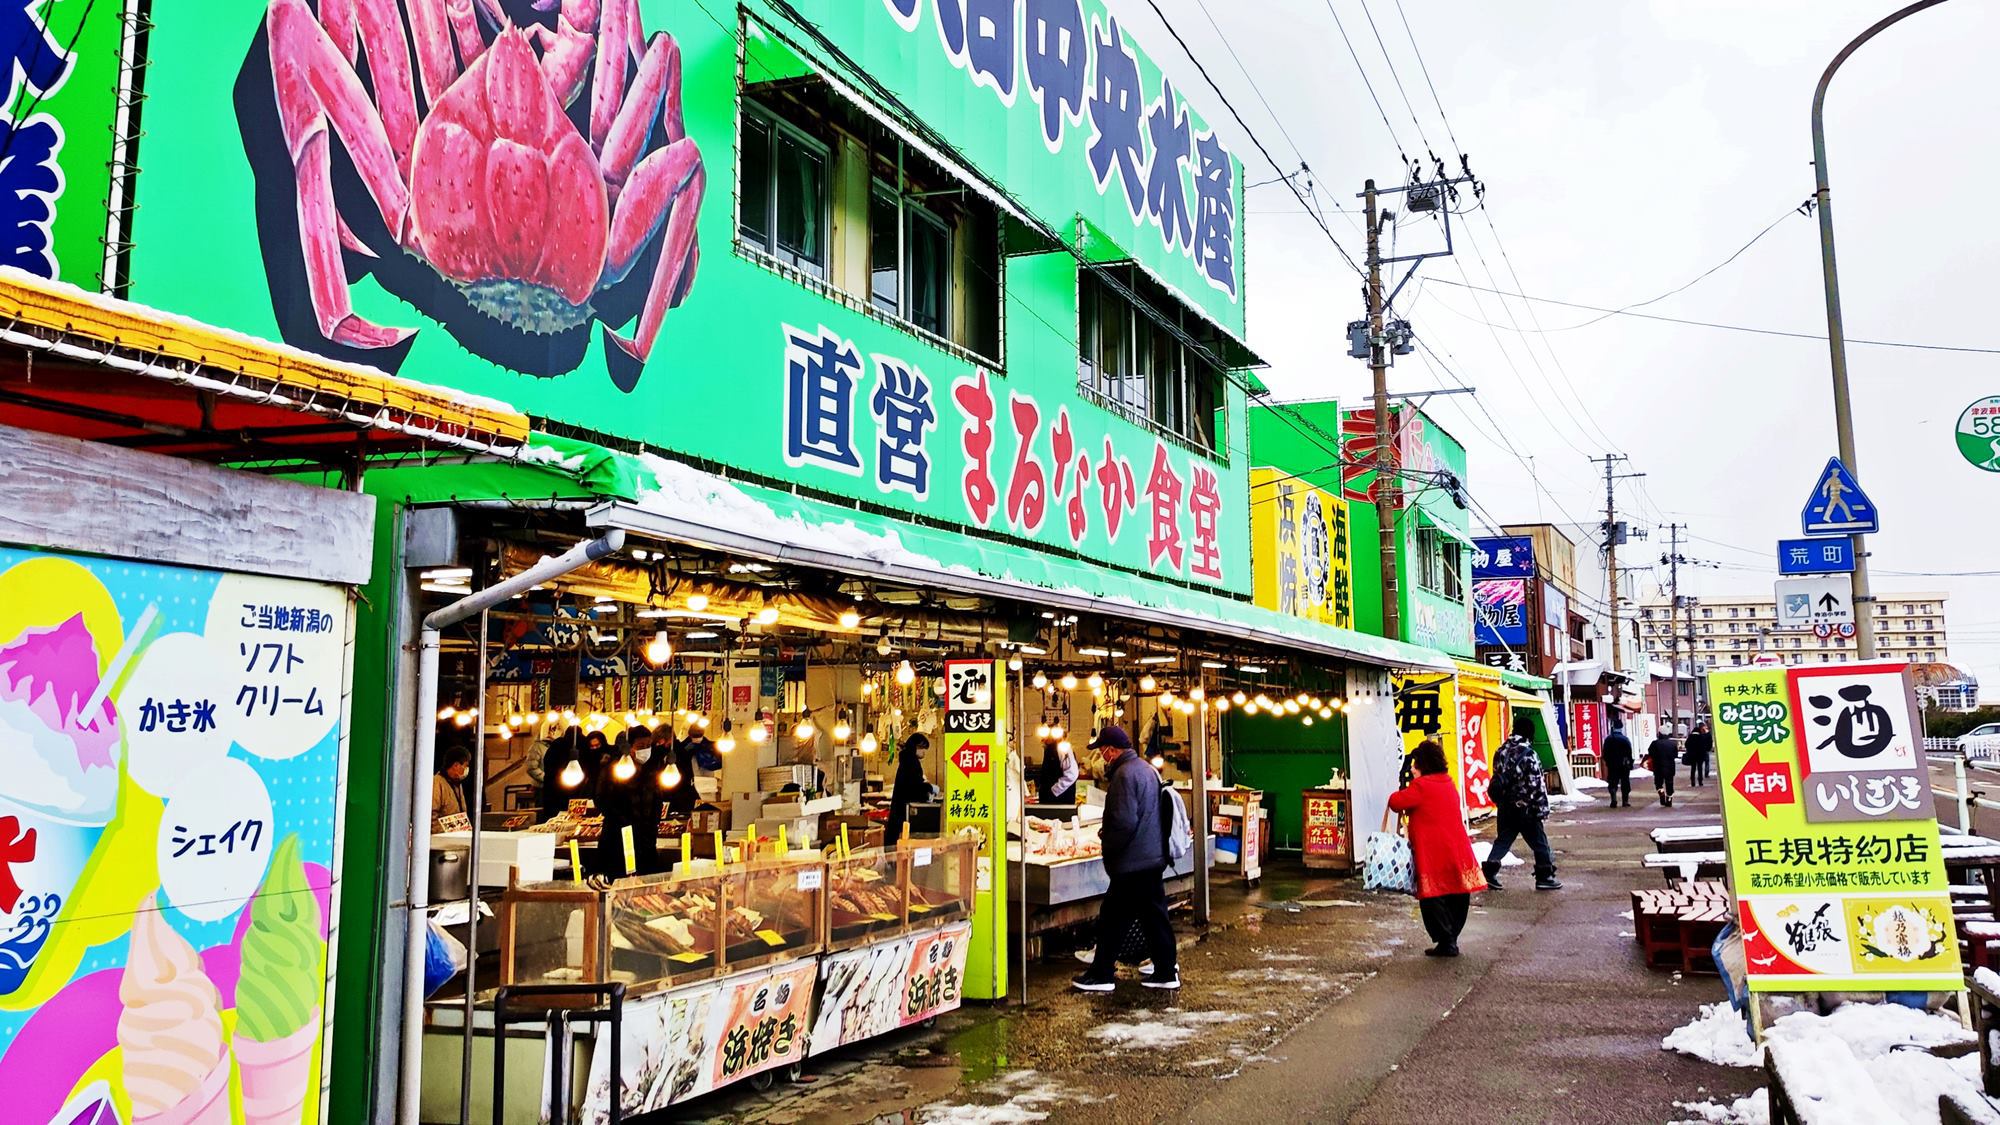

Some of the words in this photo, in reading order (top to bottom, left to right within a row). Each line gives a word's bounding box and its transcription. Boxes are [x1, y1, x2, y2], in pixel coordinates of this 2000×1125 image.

[1789, 546, 1842, 565] 荒町
[240, 605, 333, 635] ご当地新潟の
[1474, 603, 1523, 628] 物屋
[239, 643, 304, 675] ソフト
[236, 685, 324, 717] クリーム
[1724, 683, 1778, 696] 中央水産
[139, 699, 216, 733] かき氷
[1721, 702, 1784, 723] みどりの
[1808, 684, 1896, 759] 酒
[1739, 725, 1787, 744] テント
[960, 750, 986, 768] 店内
[951, 789, 977, 802] 正規
[1744, 773, 1787, 794] 店内
[950, 804, 989, 818] 特約店
[171, 820, 263, 858] シェイク
[1745, 834, 1929, 865] 正規特約店
[1751, 870, 1931, 888] 蔵元の希望小売価格で販売しています
[753, 984, 790, 1011] 名物
[907, 965, 958, 1017] 浜焼き
[722, 1012, 796, 1077] 浜焼き
